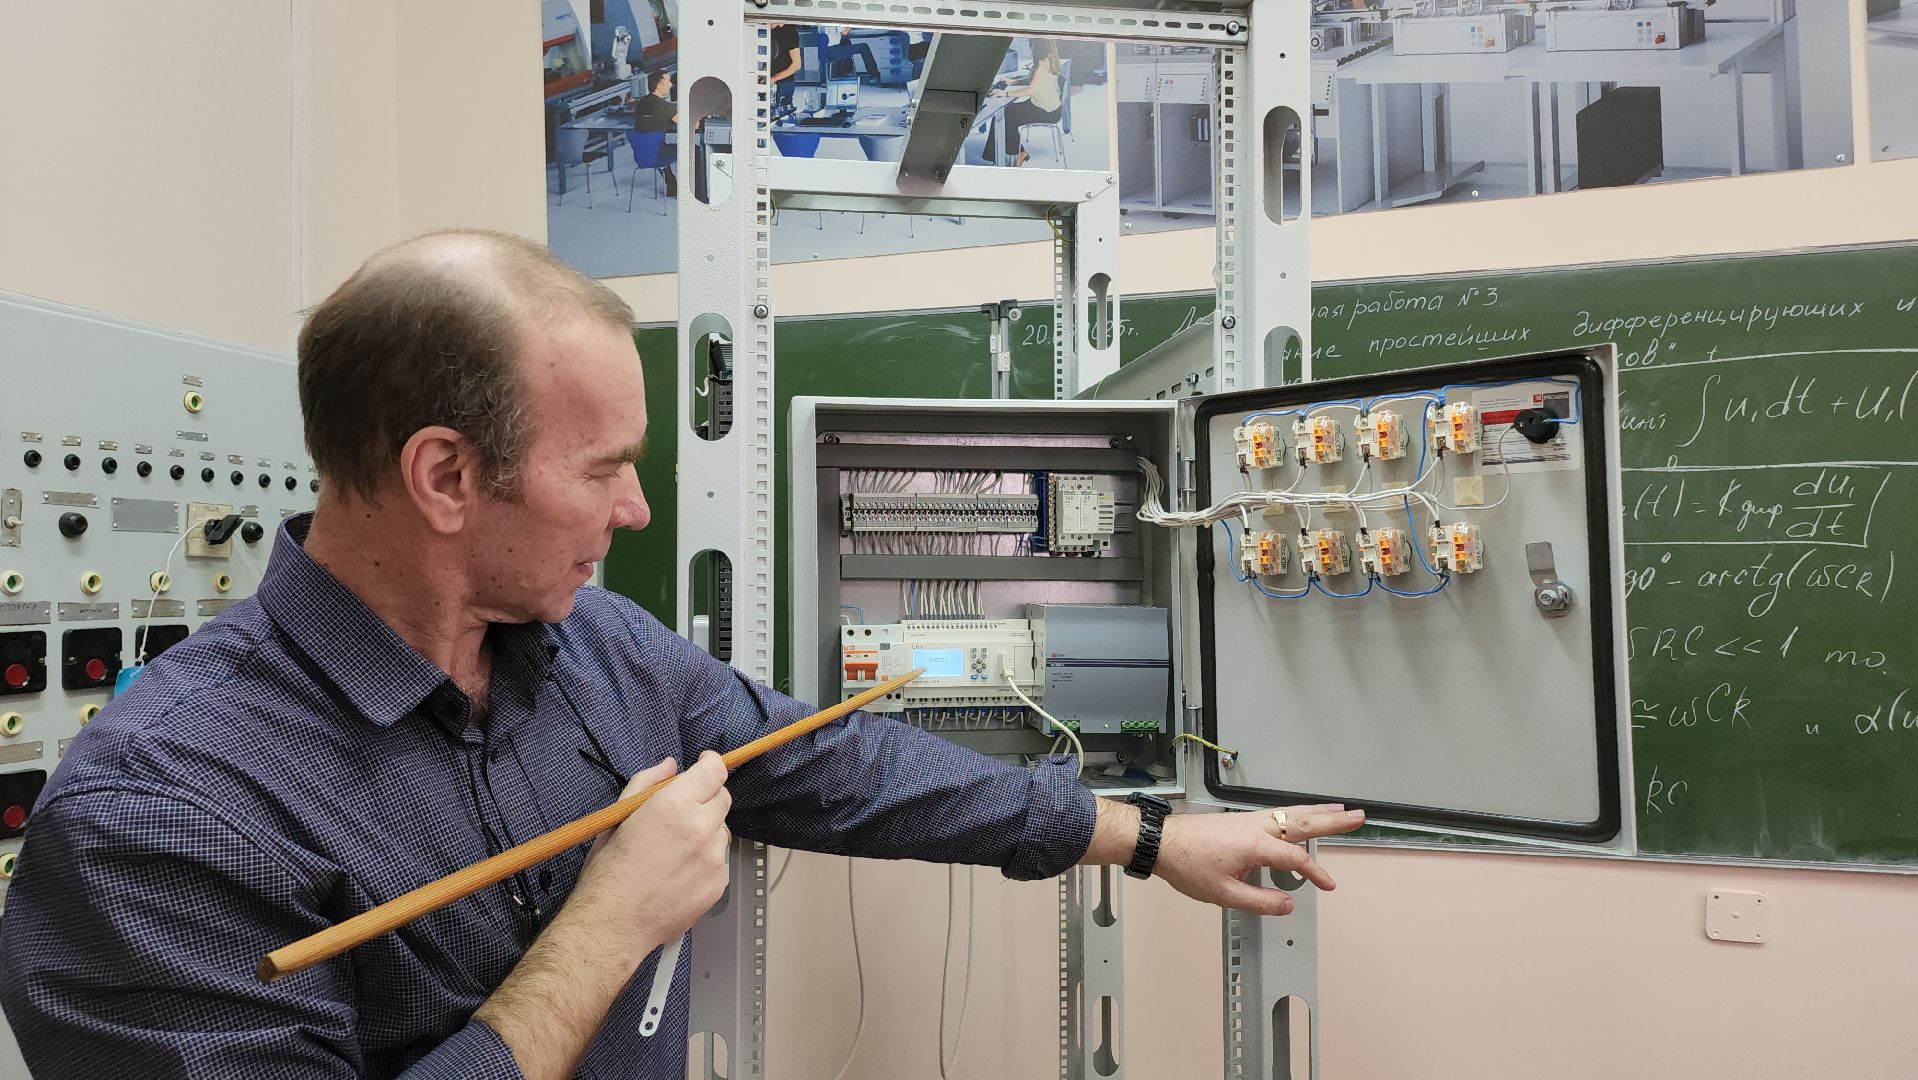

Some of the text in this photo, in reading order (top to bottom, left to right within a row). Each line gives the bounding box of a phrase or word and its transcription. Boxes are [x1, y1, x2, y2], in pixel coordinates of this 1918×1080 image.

[1346, 291, 1442, 331] работа
[1368, 327, 1531, 358] простейших
[1572, 302, 1864, 341] дифференцирующих
